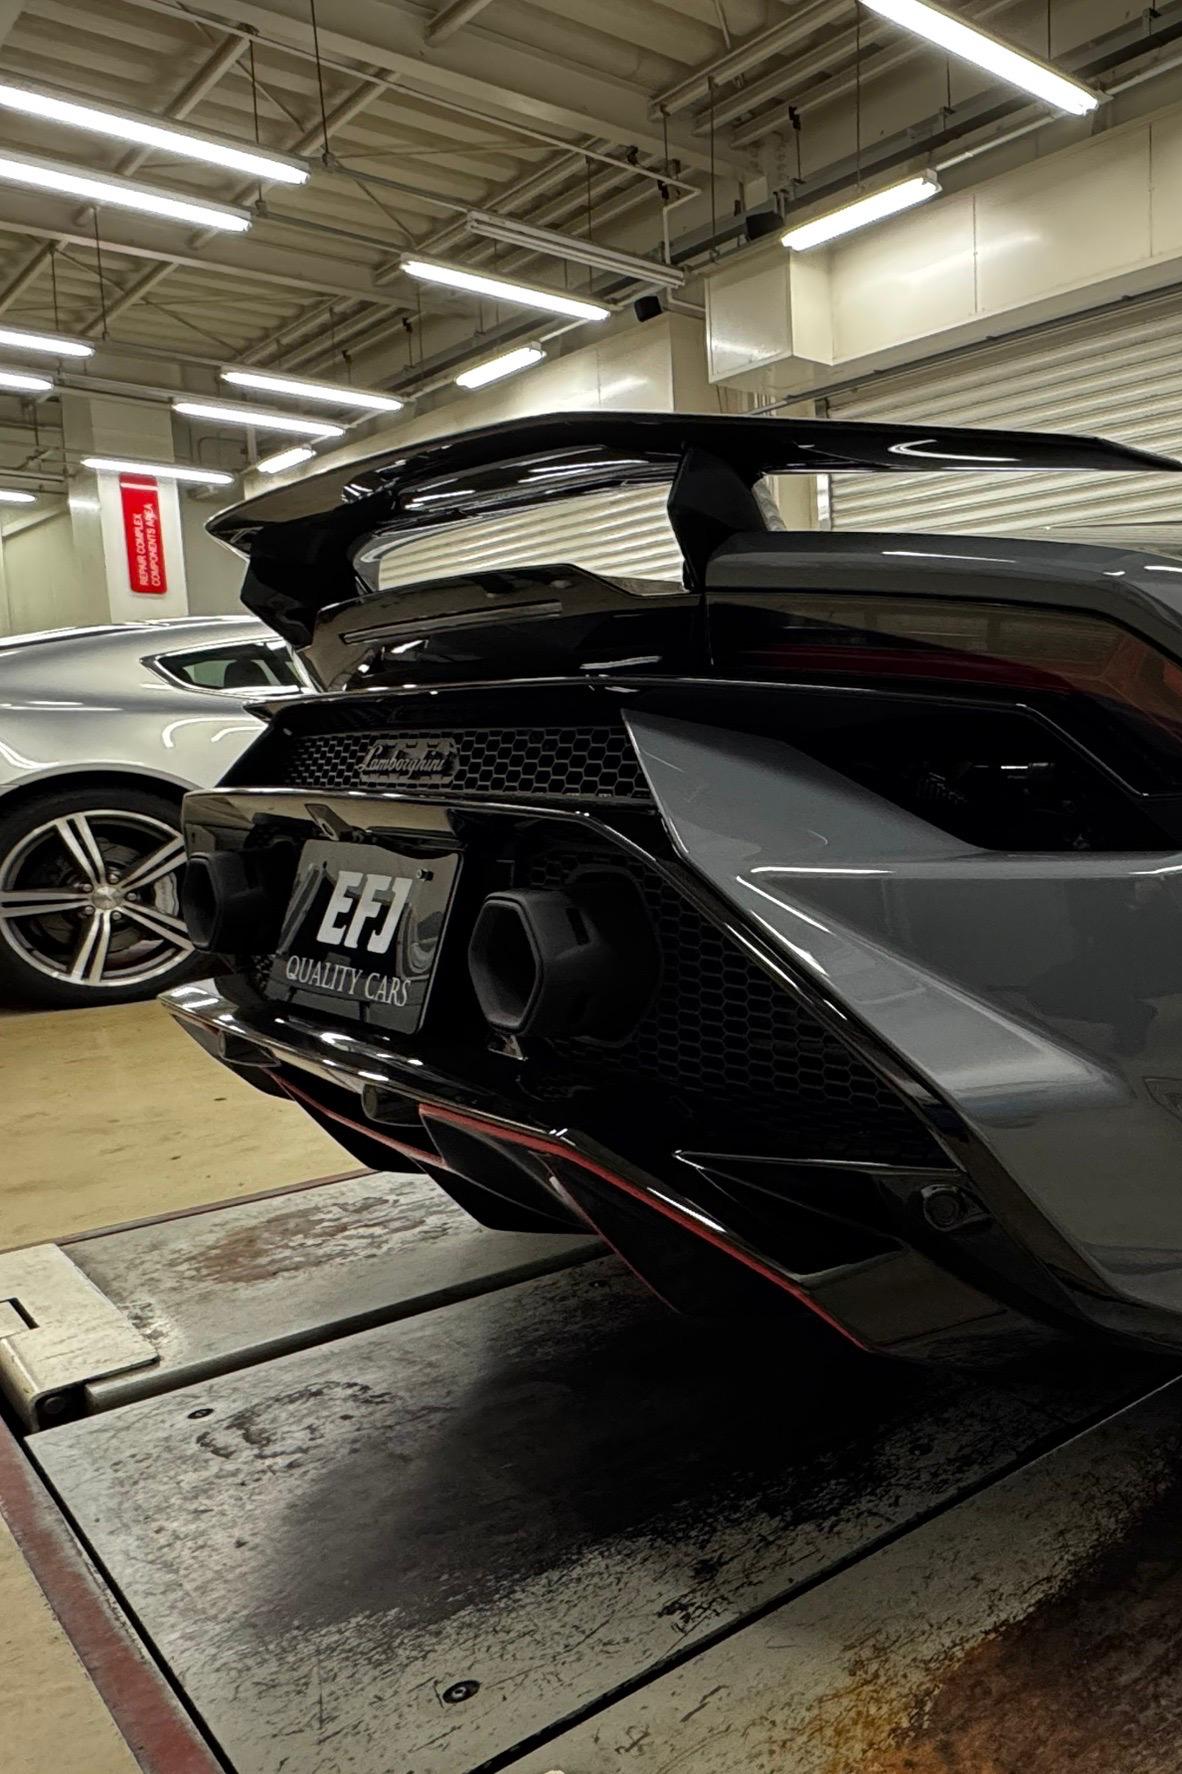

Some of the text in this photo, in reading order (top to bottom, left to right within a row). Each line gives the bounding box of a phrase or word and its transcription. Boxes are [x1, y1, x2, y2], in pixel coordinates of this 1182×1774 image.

[132, 513, 149, 586] REPAIR COMPLEX
[143, 502, 161, 587] COMPONENTS AREA
[358, 744, 446, 780] Lamborghini
[316, 870, 413, 954] EFJ
[286, 955, 411, 1007] QUALITY CARS
